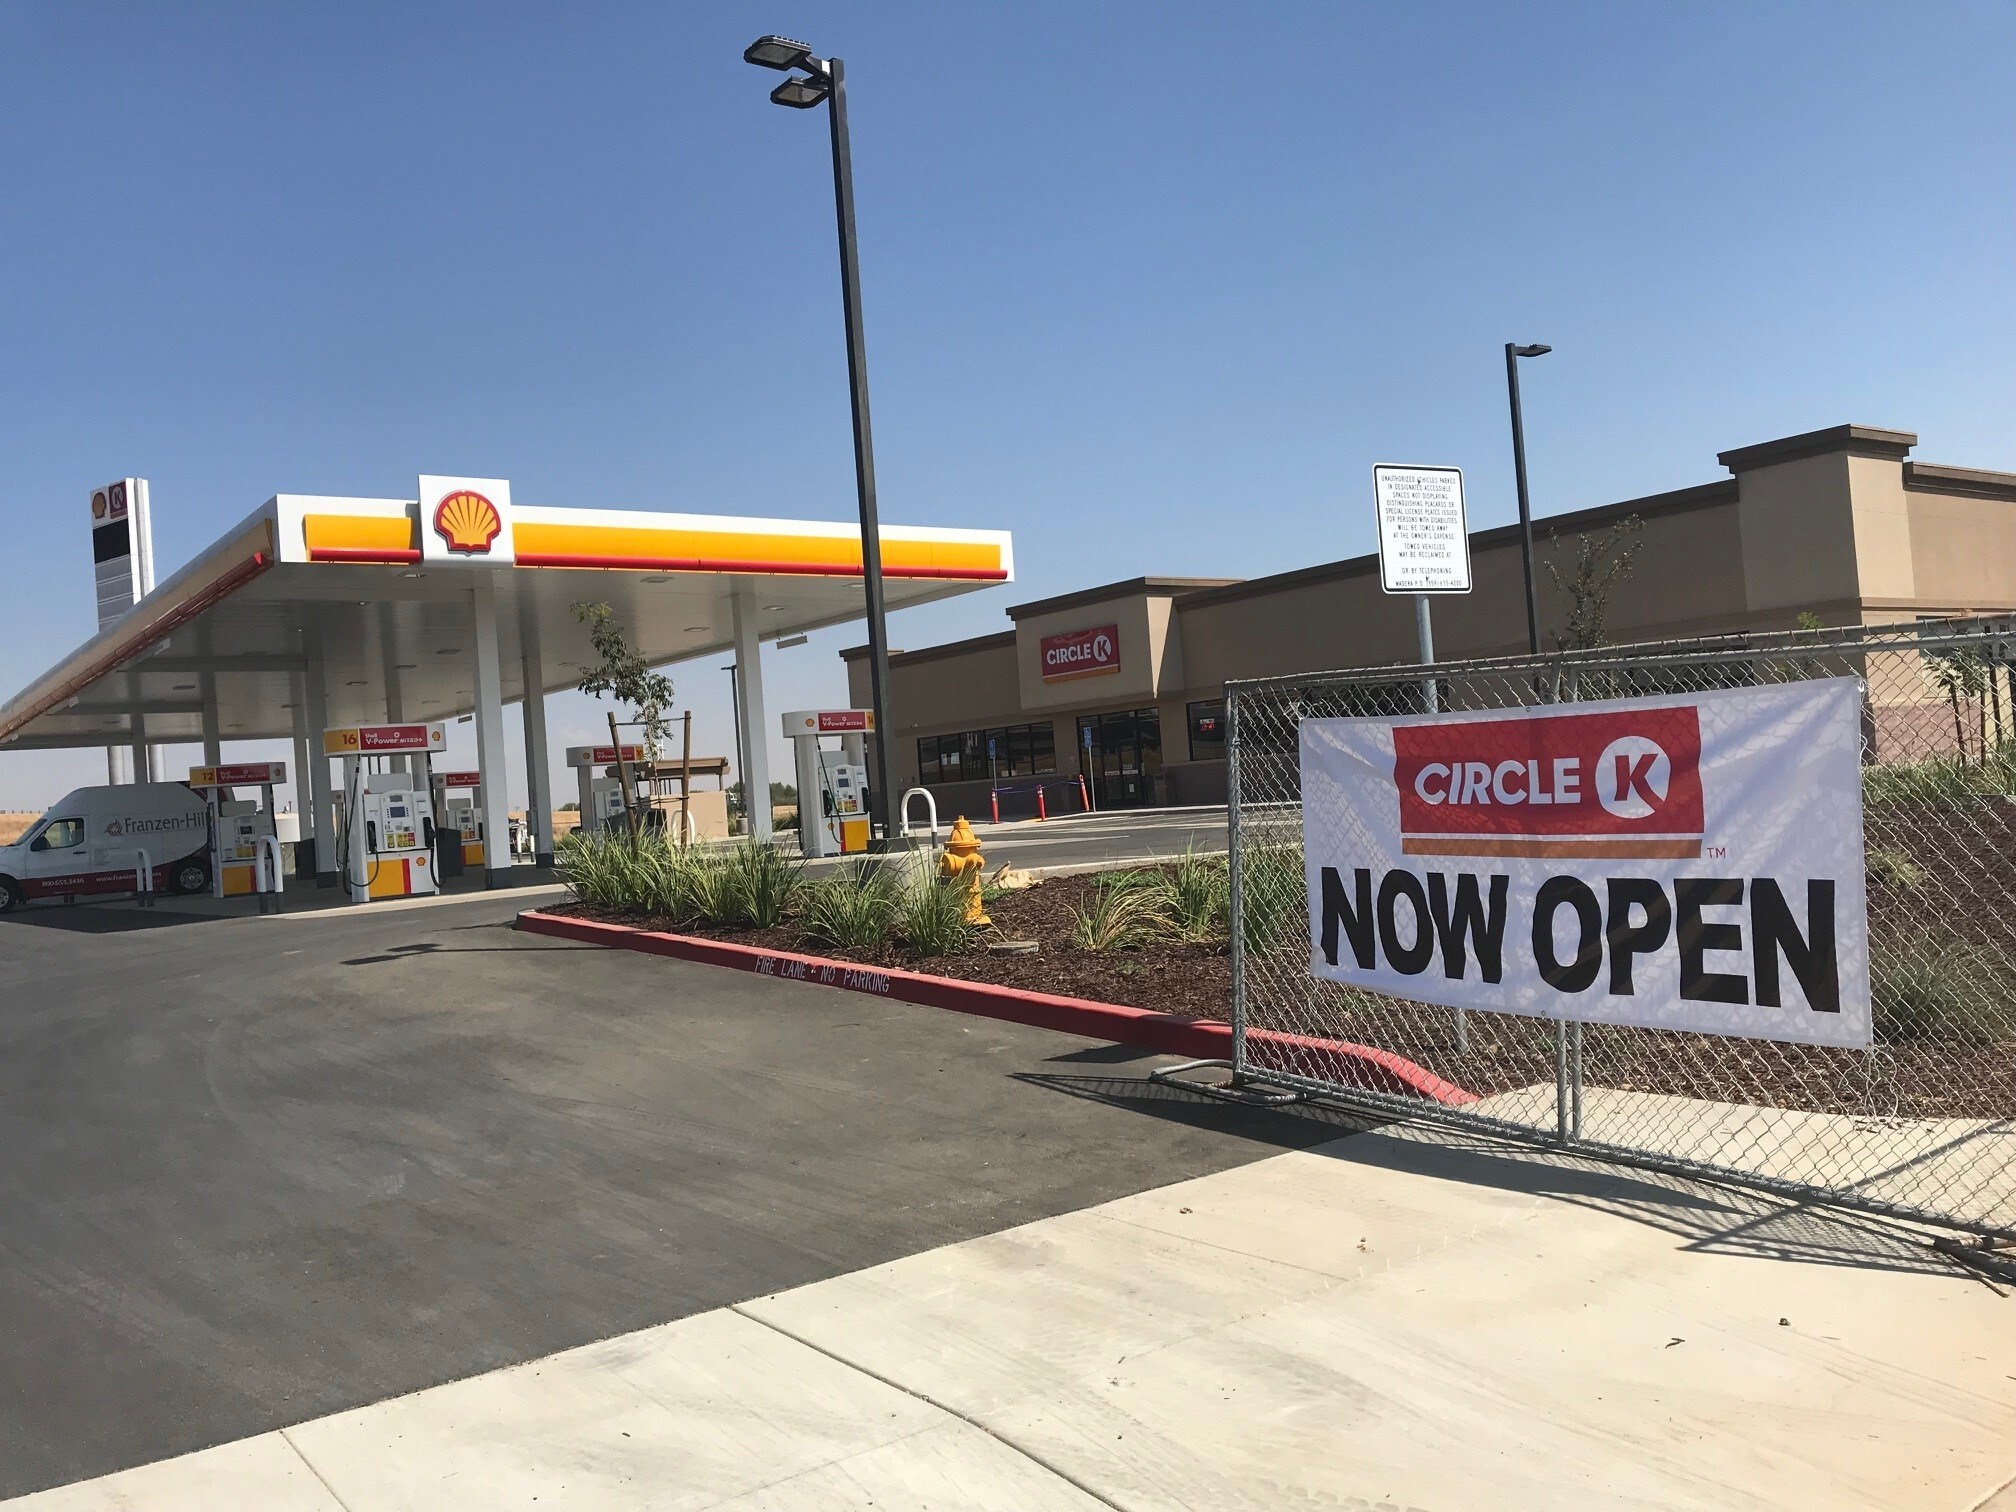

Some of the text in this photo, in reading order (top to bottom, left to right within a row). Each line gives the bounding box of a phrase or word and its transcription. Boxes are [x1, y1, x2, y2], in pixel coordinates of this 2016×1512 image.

[1047, 643, 1091, 665] CIRCLE
[342, 734, 357, 745] 16
[202, 772, 214, 781] 12
[1414, 751, 1668, 815] CIRCLE K
[1706, 846, 1726, 859] TM
[1320, 867, 1841, 1014] NOW OPEN
[754, 956, 776, 974] FIRE
[781, 959, 807, 979] LANE
[820, 965, 836, 982] NO
[843, 968, 890, 993] PARKING
